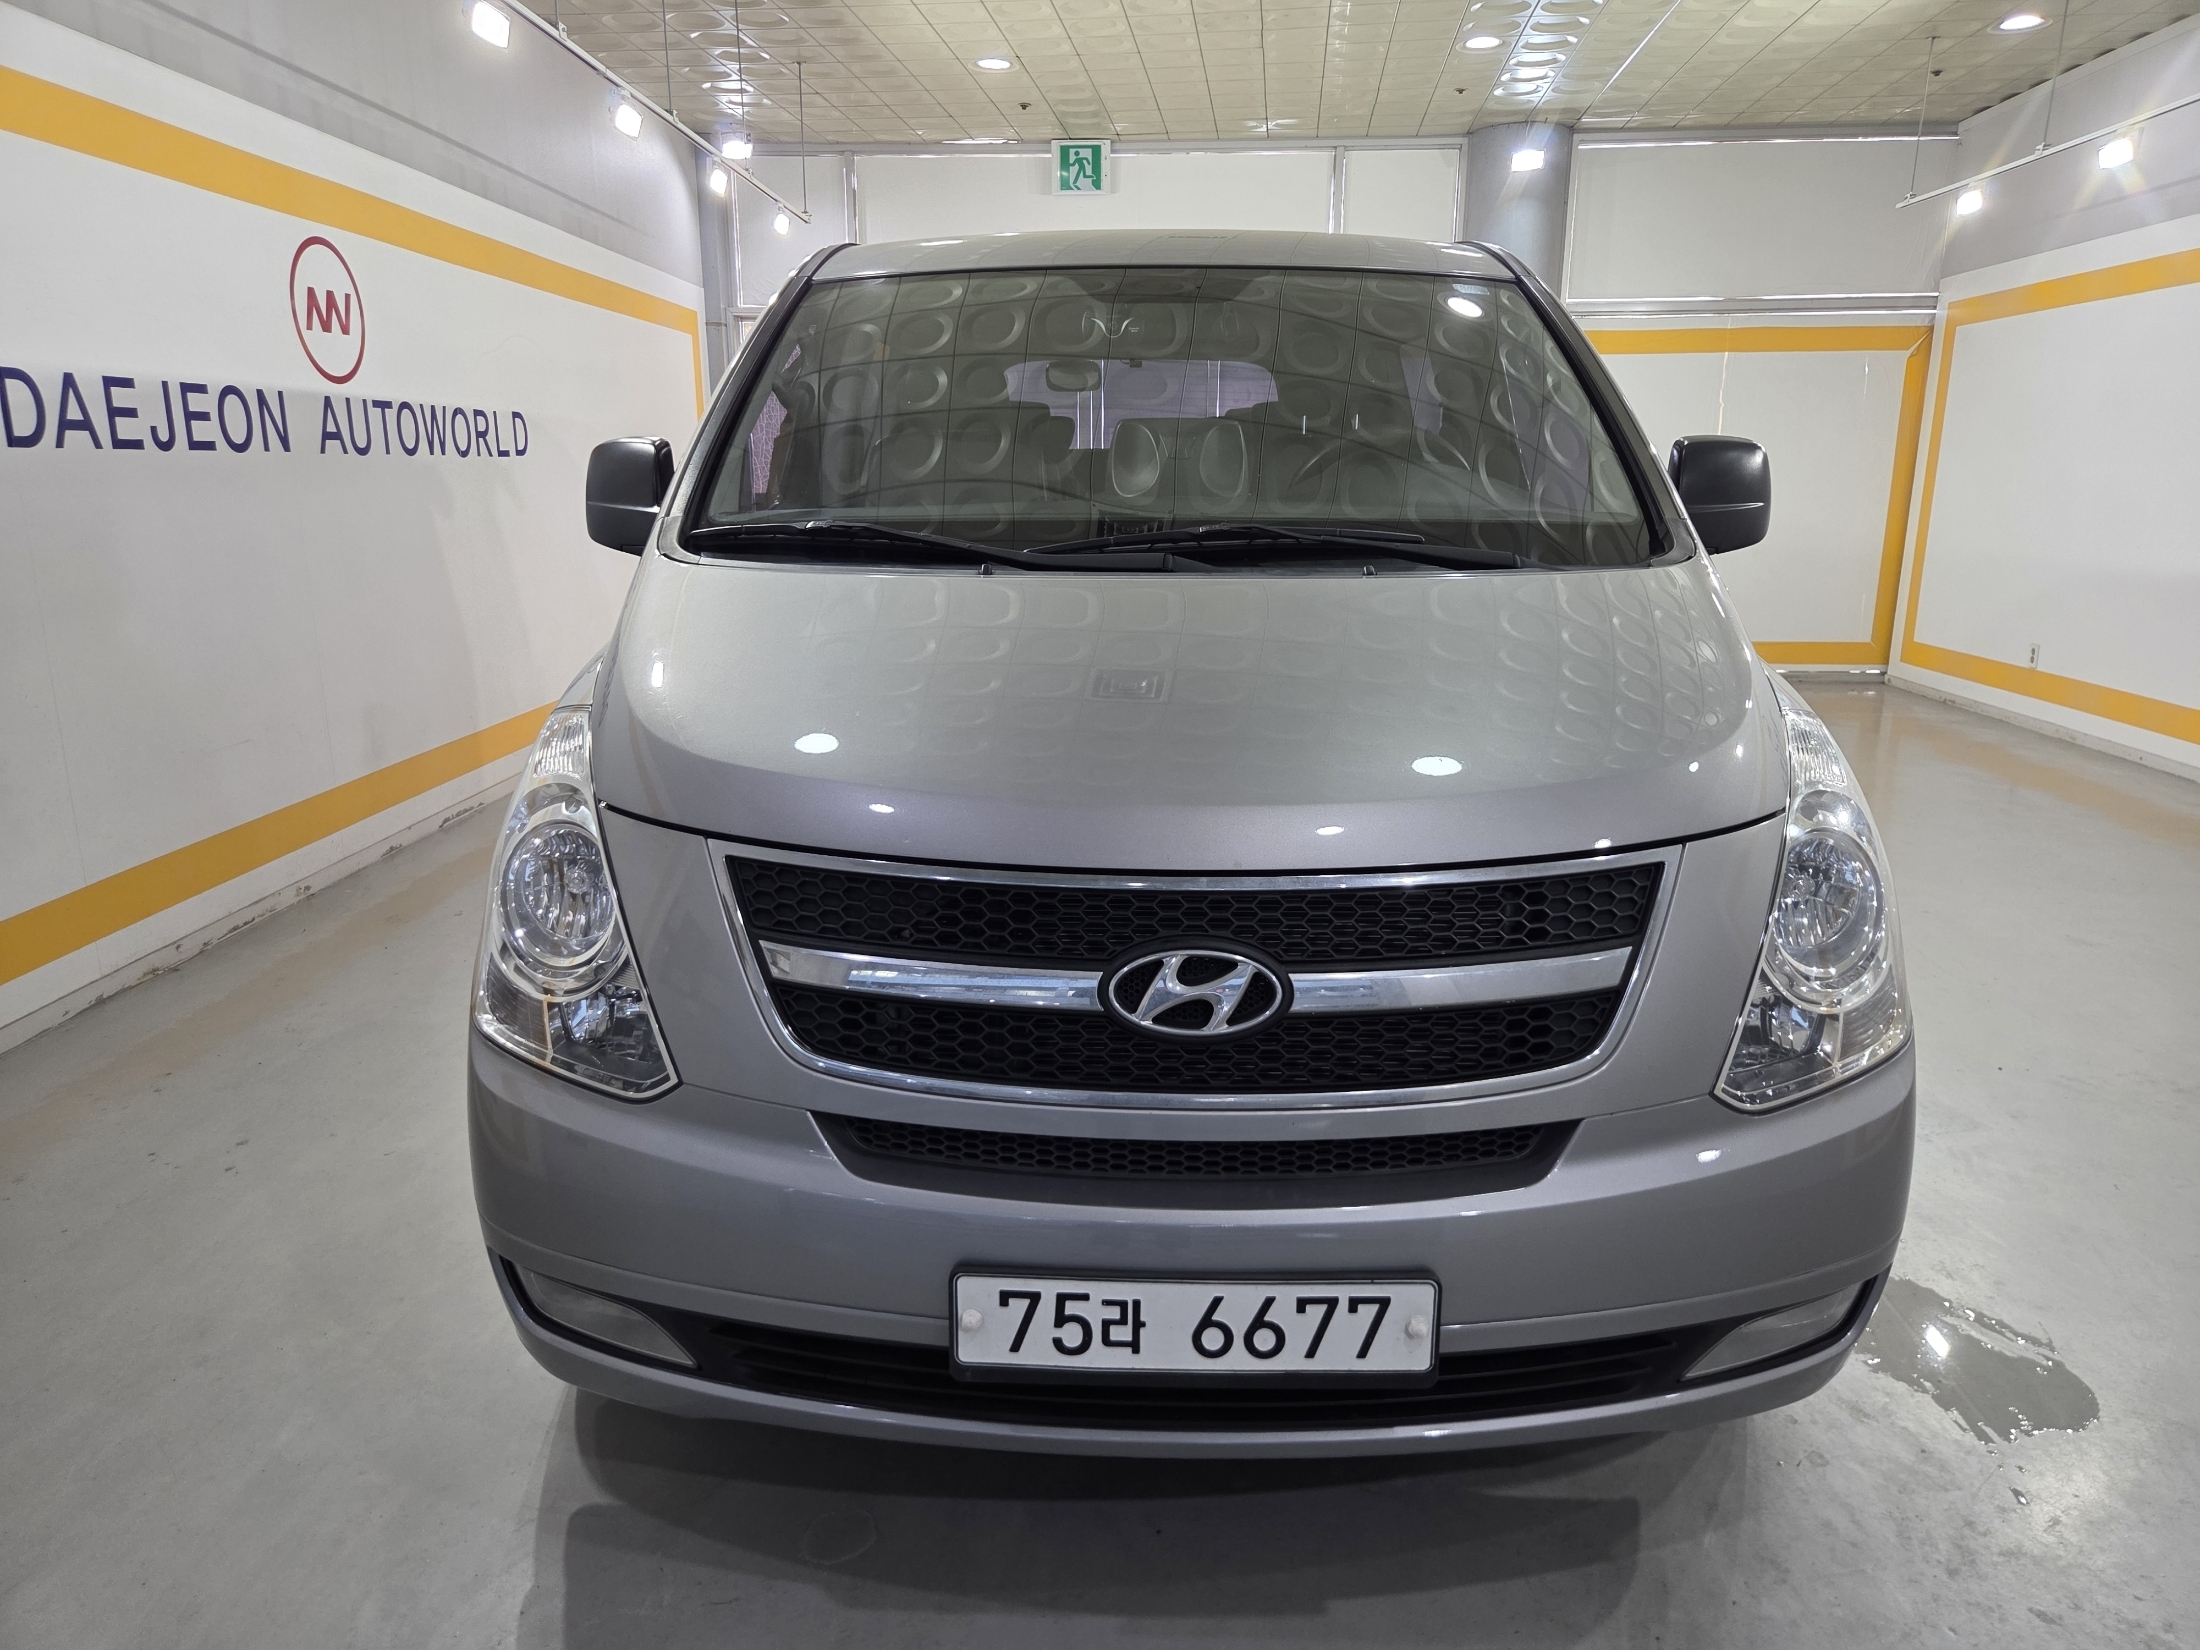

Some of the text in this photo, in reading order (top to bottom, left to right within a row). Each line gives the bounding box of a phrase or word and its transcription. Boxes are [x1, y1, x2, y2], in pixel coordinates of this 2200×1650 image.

[0, 366, 529, 459] DAEJEON AUTOWORLD
[998, 1289, 1392, 1359] 75라 6677
